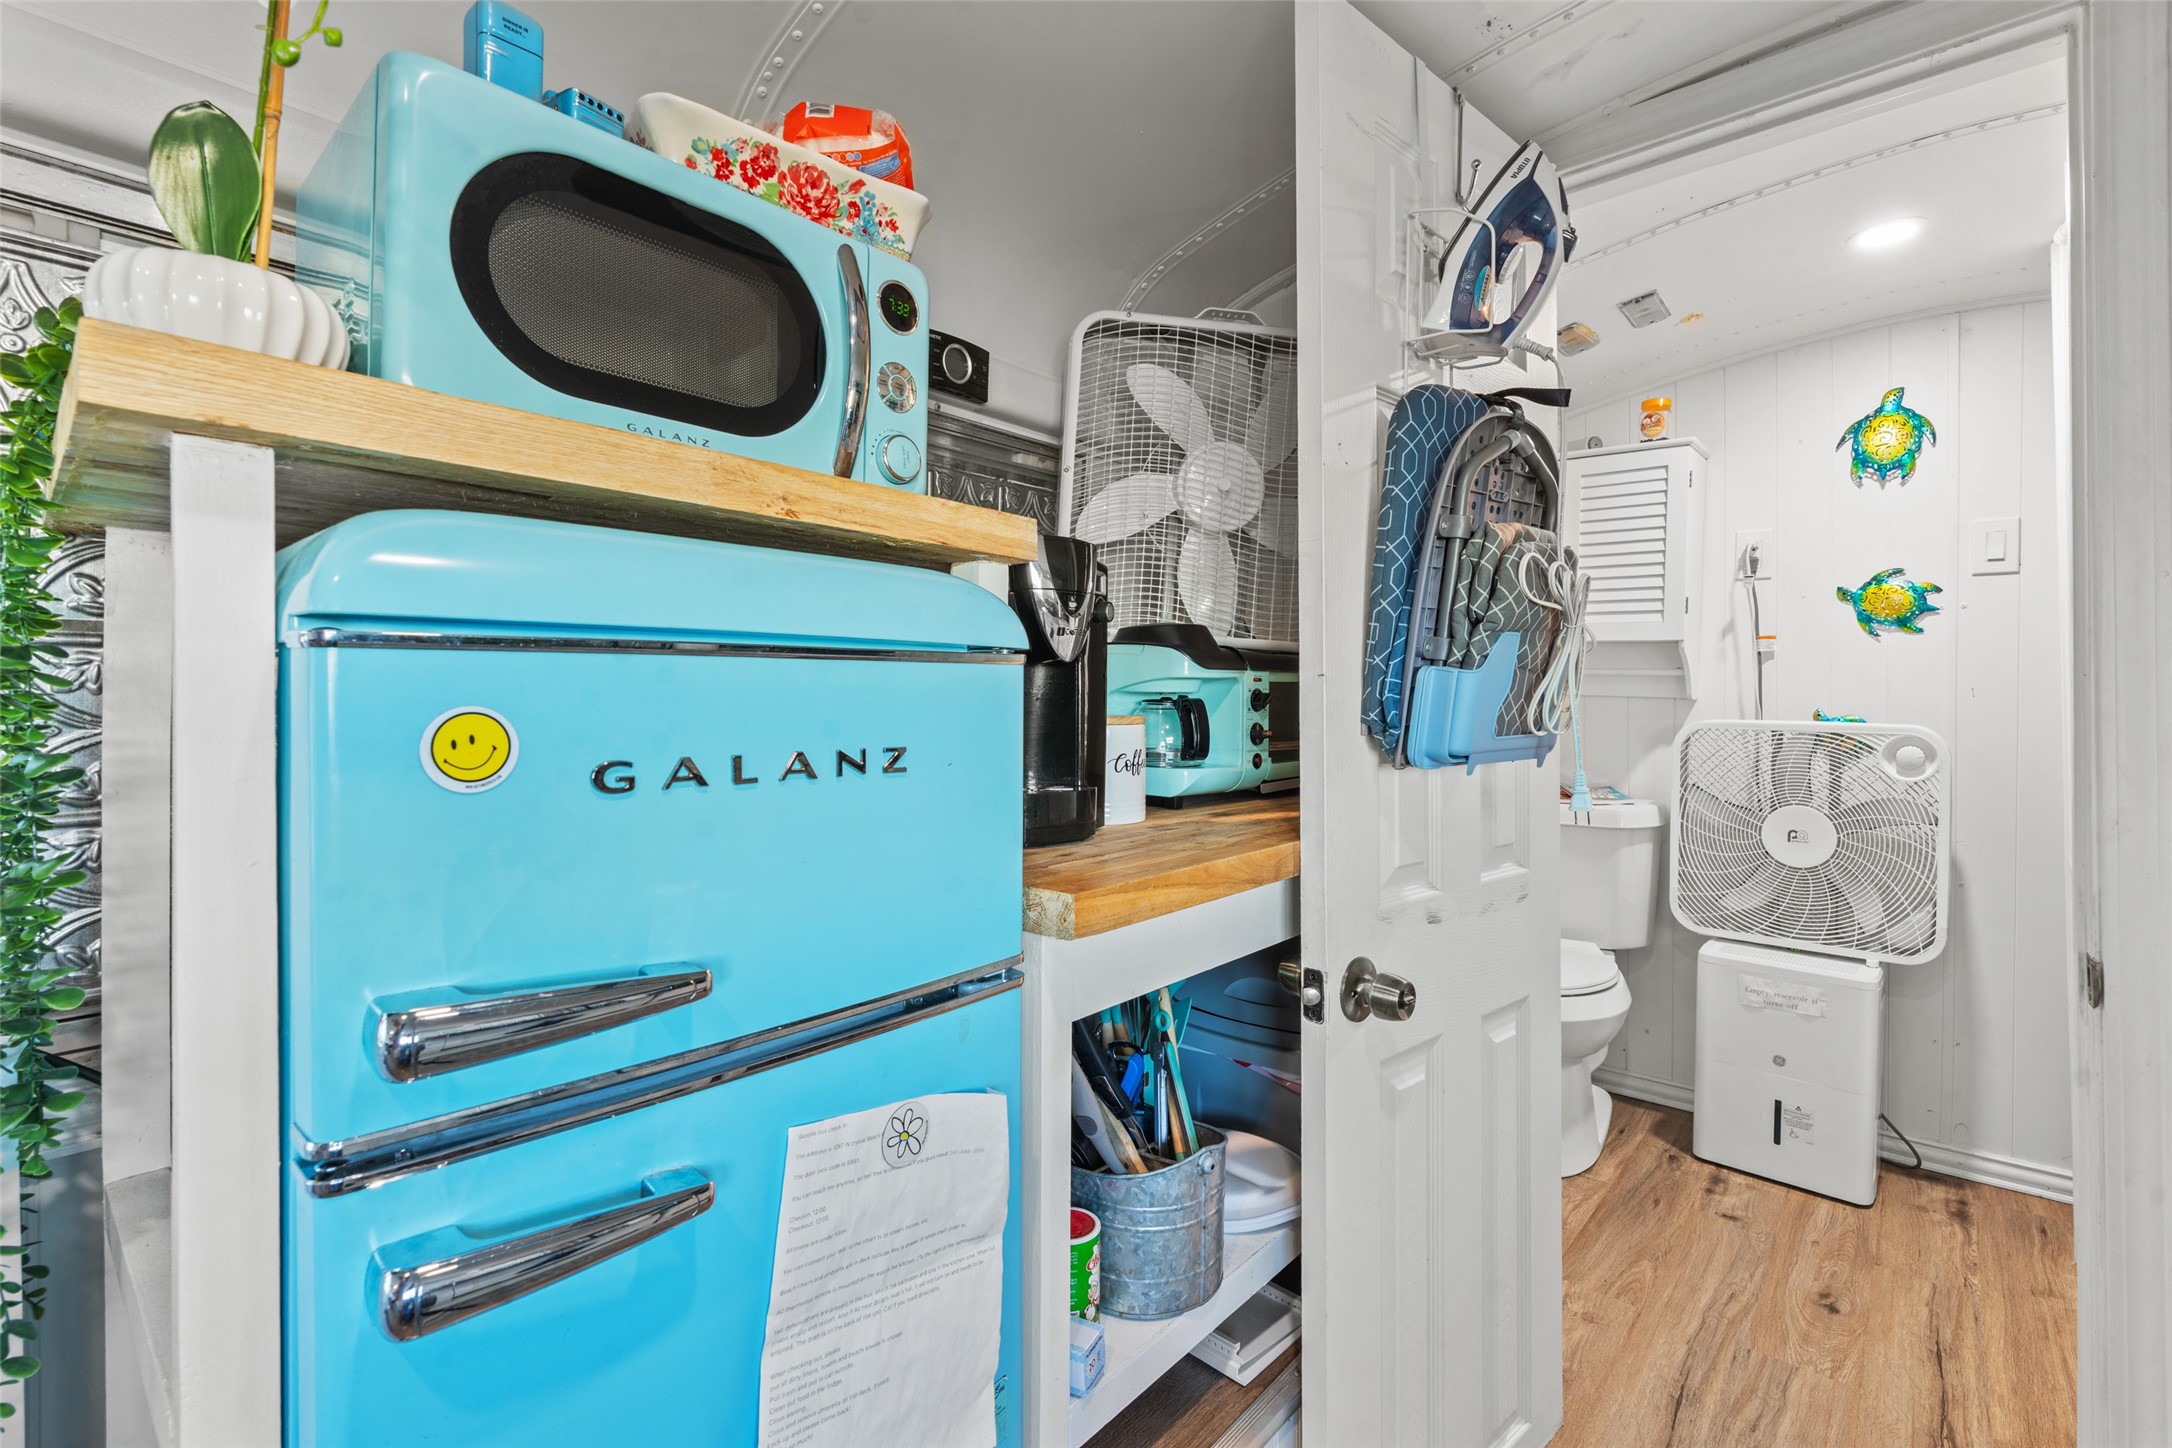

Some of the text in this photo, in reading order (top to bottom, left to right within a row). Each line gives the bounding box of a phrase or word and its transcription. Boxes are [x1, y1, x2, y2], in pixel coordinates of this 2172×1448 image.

[502, 16, 522, 30] DINNER
[1510, 157, 1531, 179] UTOPIA
[889, 298, 910, 317] 7:33
[626, 422, 710, 448] GALANZ
[590, 746, 907, 794] GALANZ
[1744, 986, 1769, 997] Empty
[1774, 991, 1808, 1003] reservoir
[1764, 1000, 1784, 1008] turns
[806, 1148, 827, 1158] address
[828, 1163, 840, 1171] code
[812, 1187, 826, 1196] reach
[788, 1221, 813, 1234] Checkout:
[789, 1212, 812, 1223] Checkin:
[820, 1234, 833, 1242] under
[804, 1256, 826, 1267] connect
[826, 1251, 836, 1260] your
[862, 1236, 876, 1244] smart
[780, 1286, 796, 1296] Beach
[813, 1275, 824, 1283] and
[824, 1266, 845, 1278] umbrella
[859, 1256, 870, 1264] deck
[785, 1296, 814, 1312] thermostat
[838, 1278, 860, 1291] mounted
[829, 1301, 849, 1314] present
[897, 1274, 918, 1286] bathroom
[890, 1291, 900, 1299] seat
[808, 1334, 820, 1343] drain
[844, 1320, 855, 1328] back
[884, 1304, 892, 1312] Call
[770, 1360, 812, 1380] When checking
[788, 1375, 801, 1384] dirty
[821, 1360, 837, 1370] towels
[838, 1353, 848, 1362] and
[848, 1348, 864, 1358] beach
[770, 1394, 780, 1403] Pull
[782, 1389, 796, 1398] trash
[797, 1382, 807, 1391] and
[808, 1379, 818, 1388] put
[769, 1404, 786, 1415] Clean
[786, 1398, 796, 1407] out
[797, 1392, 809, 1402] food
[768, 1427, 784, 1438] Close
[785, 1421, 796, 1430] and
[797, 1412, 817, 1423] remove
[818, 1401, 841, 1414] umbrella
[768, 1416, 785, 1426] Close
[767, 1439, 780, 1448] Lock
[791, 1428, 802, 1438] and
[802, 1420, 820, 1433] please
[821, 1413, 836, 1424] come
